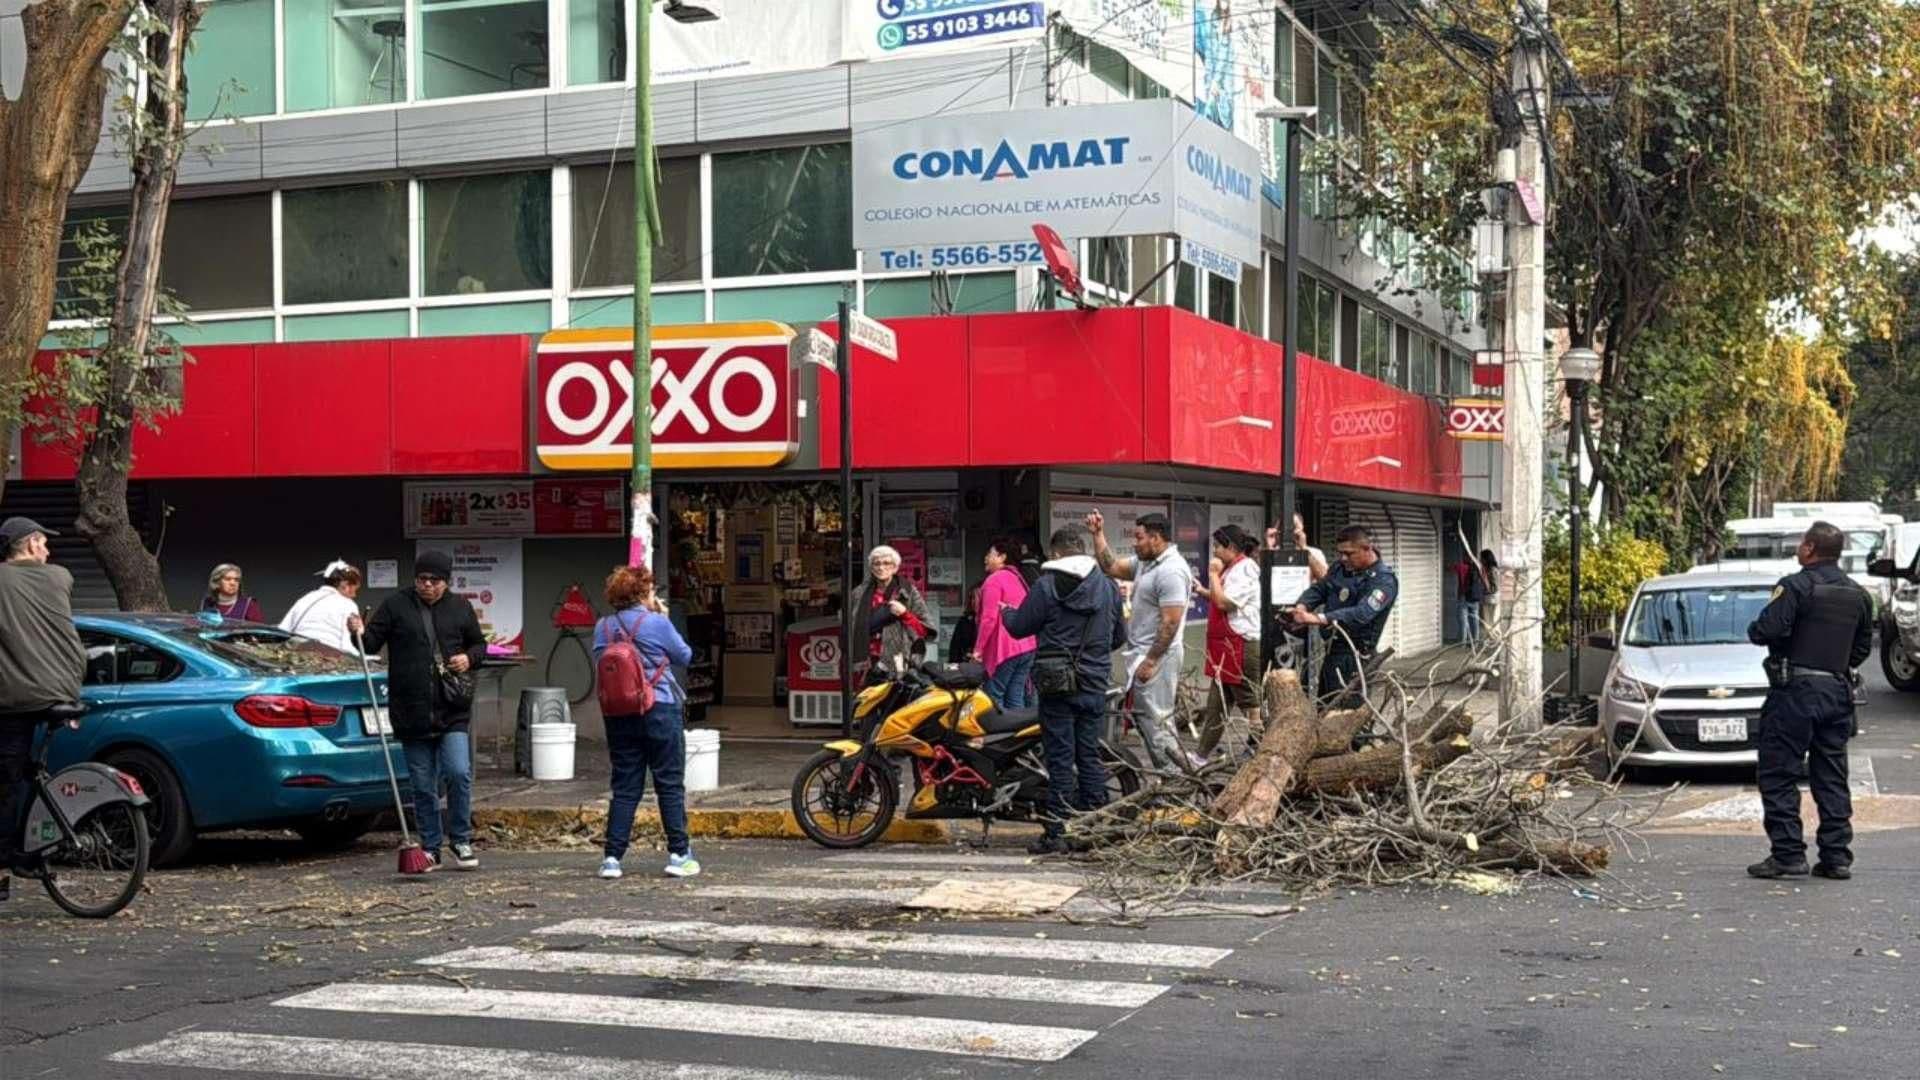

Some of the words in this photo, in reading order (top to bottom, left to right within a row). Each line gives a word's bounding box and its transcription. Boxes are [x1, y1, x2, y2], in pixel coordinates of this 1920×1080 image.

[906, 24, 928, 41] 55
[933, 16, 979, 37] 9103
[984, 9, 1030, 29] 3446
[893, 136, 1130, 181] CONAMAT
[1187, 145, 1251, 200] CONAMAT
[864, 205, 932, 221] COLEGIO
[937, 200, 1022, 216] NACIONAL
[1024, 199, 1043, 213] DE
[1046, 191, 1161, 211] MATEMÁTICAS
[881, 249, 924, 270] Tel:
[931, 243, 1043, 267] 5566-552
[545, 352, 778, 440] OXXO
[1450, 407, 1505, 432] OXX
